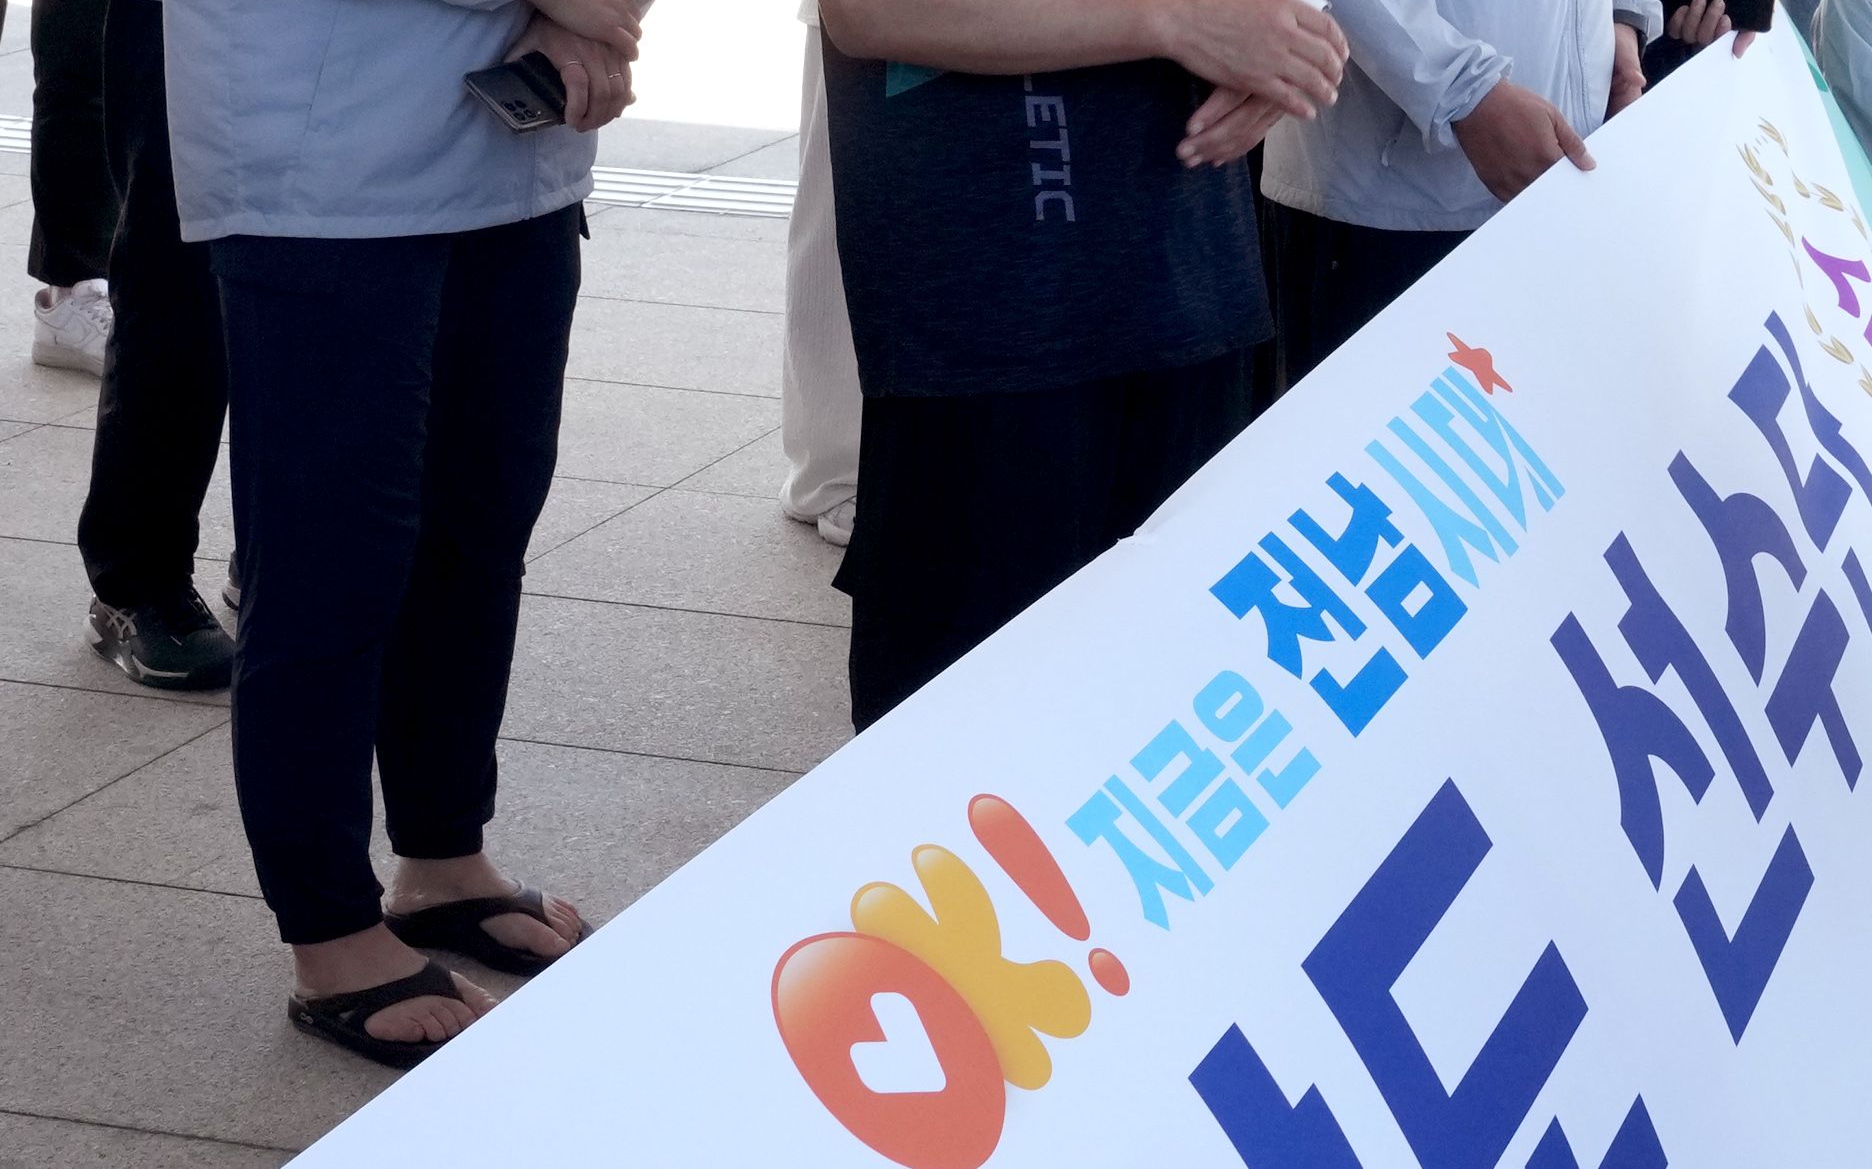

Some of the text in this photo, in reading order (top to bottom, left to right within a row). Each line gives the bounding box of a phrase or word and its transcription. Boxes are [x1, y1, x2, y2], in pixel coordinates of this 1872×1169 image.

[1023, 74, 1076, 222] ETIC
[770, 792, 1131, 1169] OK!
[1063, 669, 1322, 932] 지금은
[1208, 365, 1567, 739] 전남시대
